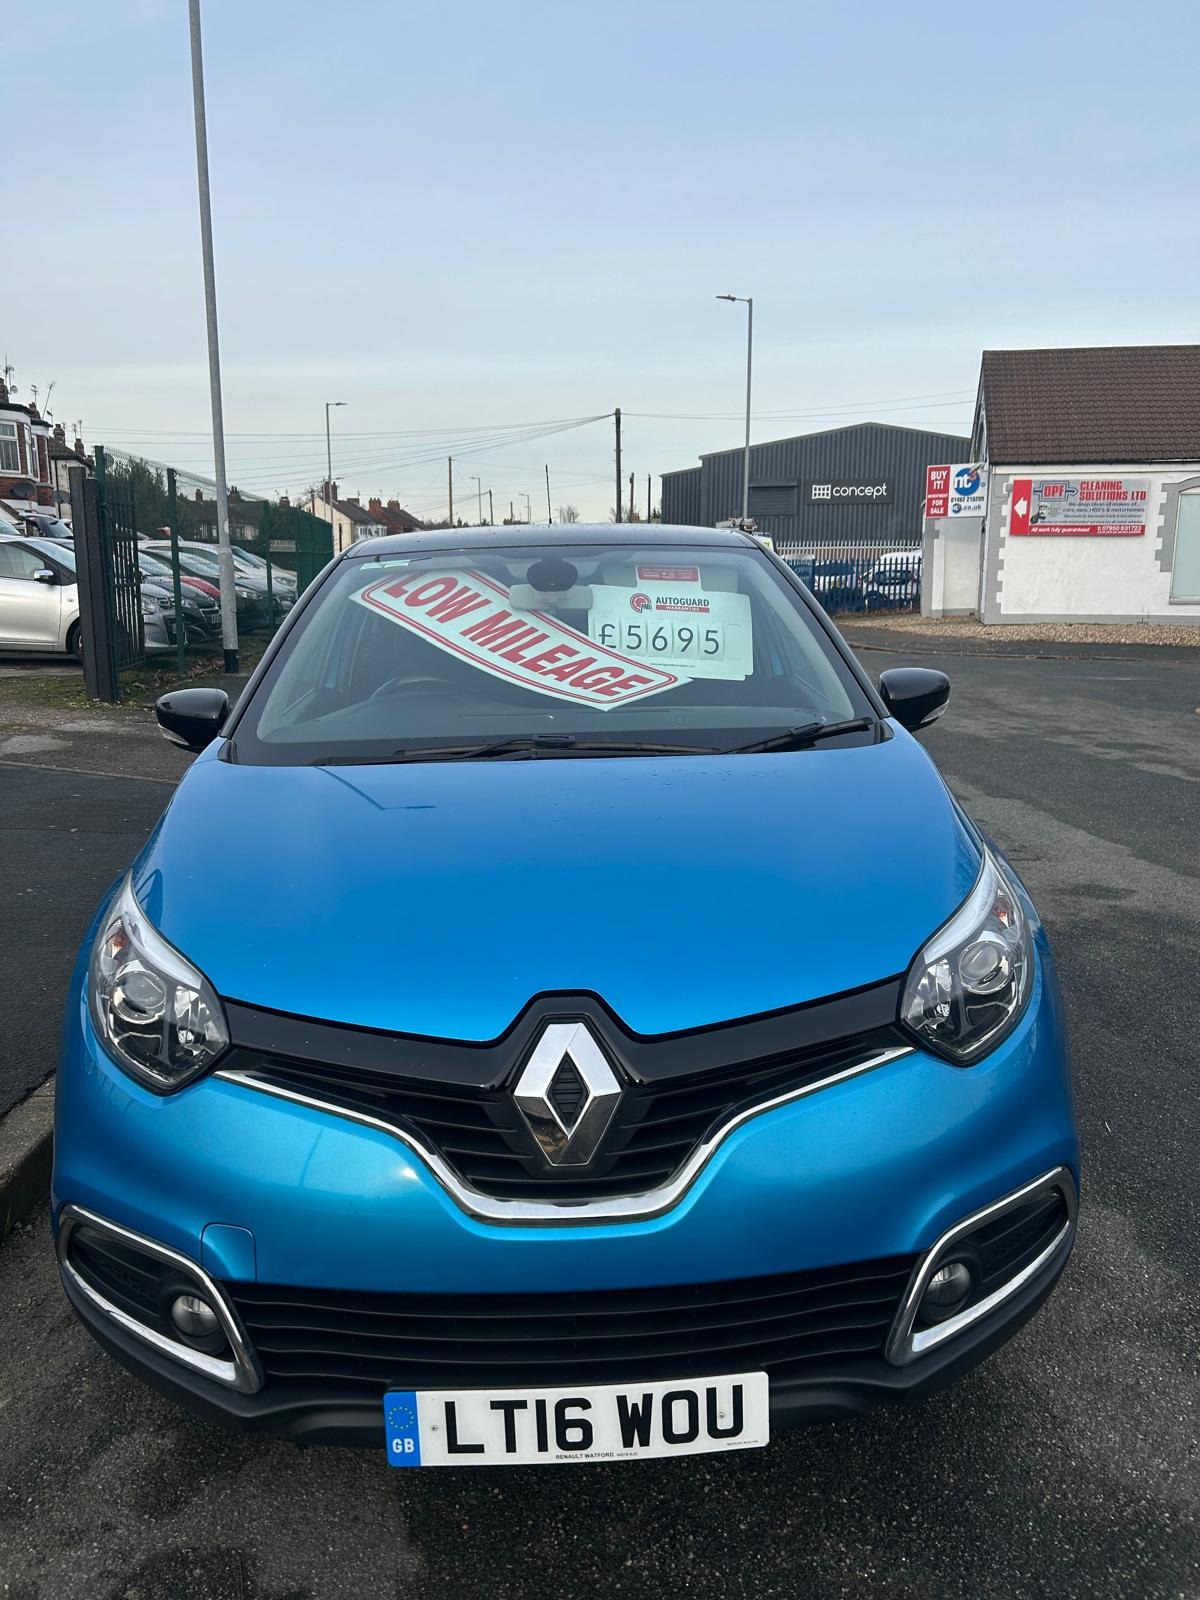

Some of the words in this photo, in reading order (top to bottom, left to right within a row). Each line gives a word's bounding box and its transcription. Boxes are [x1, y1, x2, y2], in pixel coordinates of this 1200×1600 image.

[931, 470, 948, 481] BUY
[832, 482, 887, 499] concept
[933, 480, 944, 490] IT!
[1080, 480, 1123, 490] CLEANING
[1079, 491, 1128, 501] SOLUTIONS
[1131, 490, 1147, 500] LTD
[656, 596, 710, 607] AUTOGUARD
[383, 569, 493, 624] LOW
[459, 609, 656, 697] MILEAGE
[444, 1396, 594, 1455] LT16
[615, 1383, 744, 1449] WOU
[392, 1437, 415, 1454] GB
